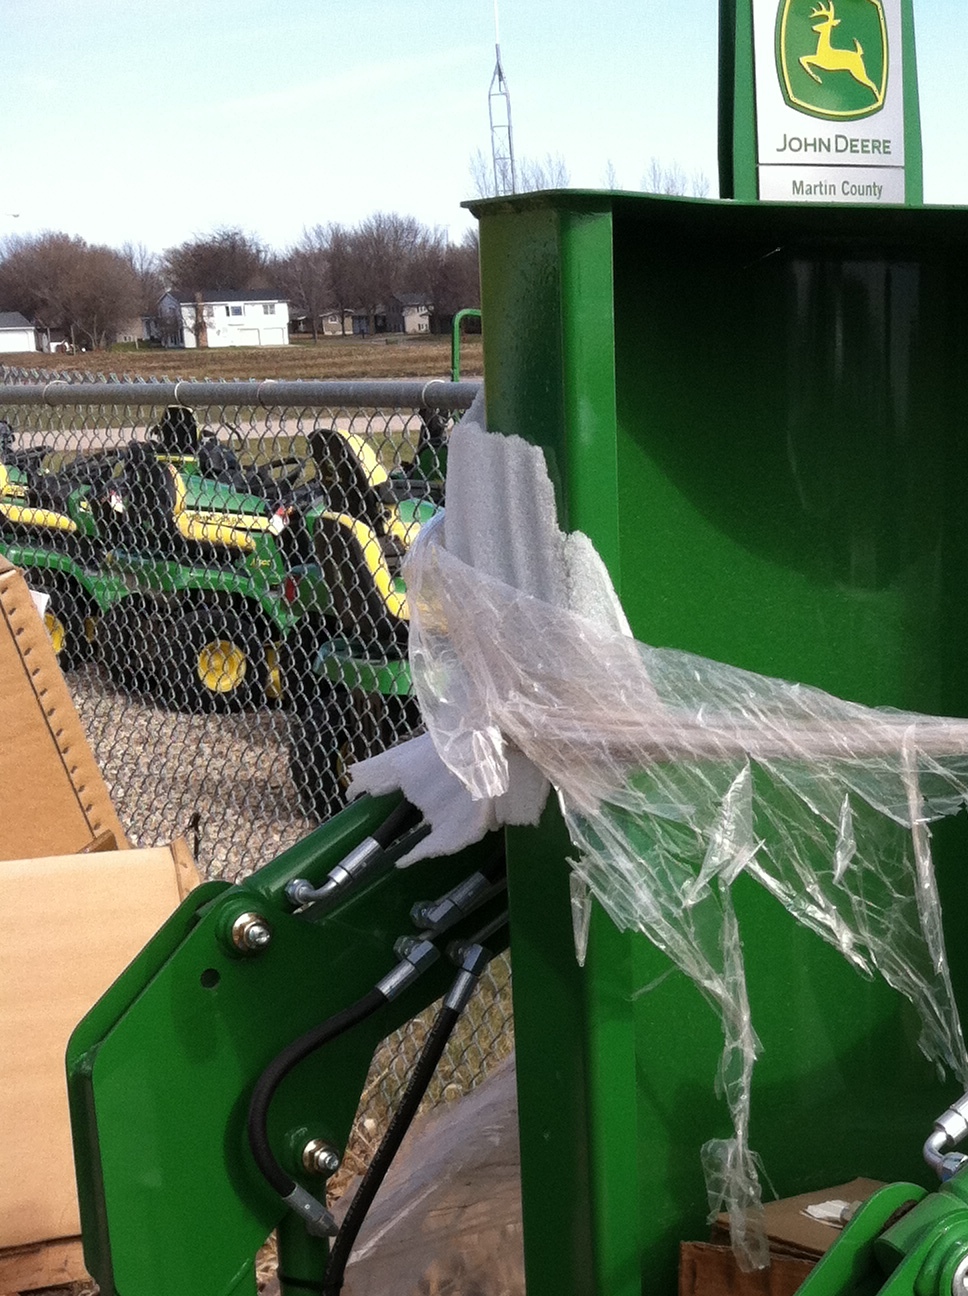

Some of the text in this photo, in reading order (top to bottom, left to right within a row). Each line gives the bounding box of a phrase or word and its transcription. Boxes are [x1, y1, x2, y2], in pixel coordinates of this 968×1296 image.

[776, 134, 891, 154] JOHN DEERE
[792, 180, 883, 200] Martin County
